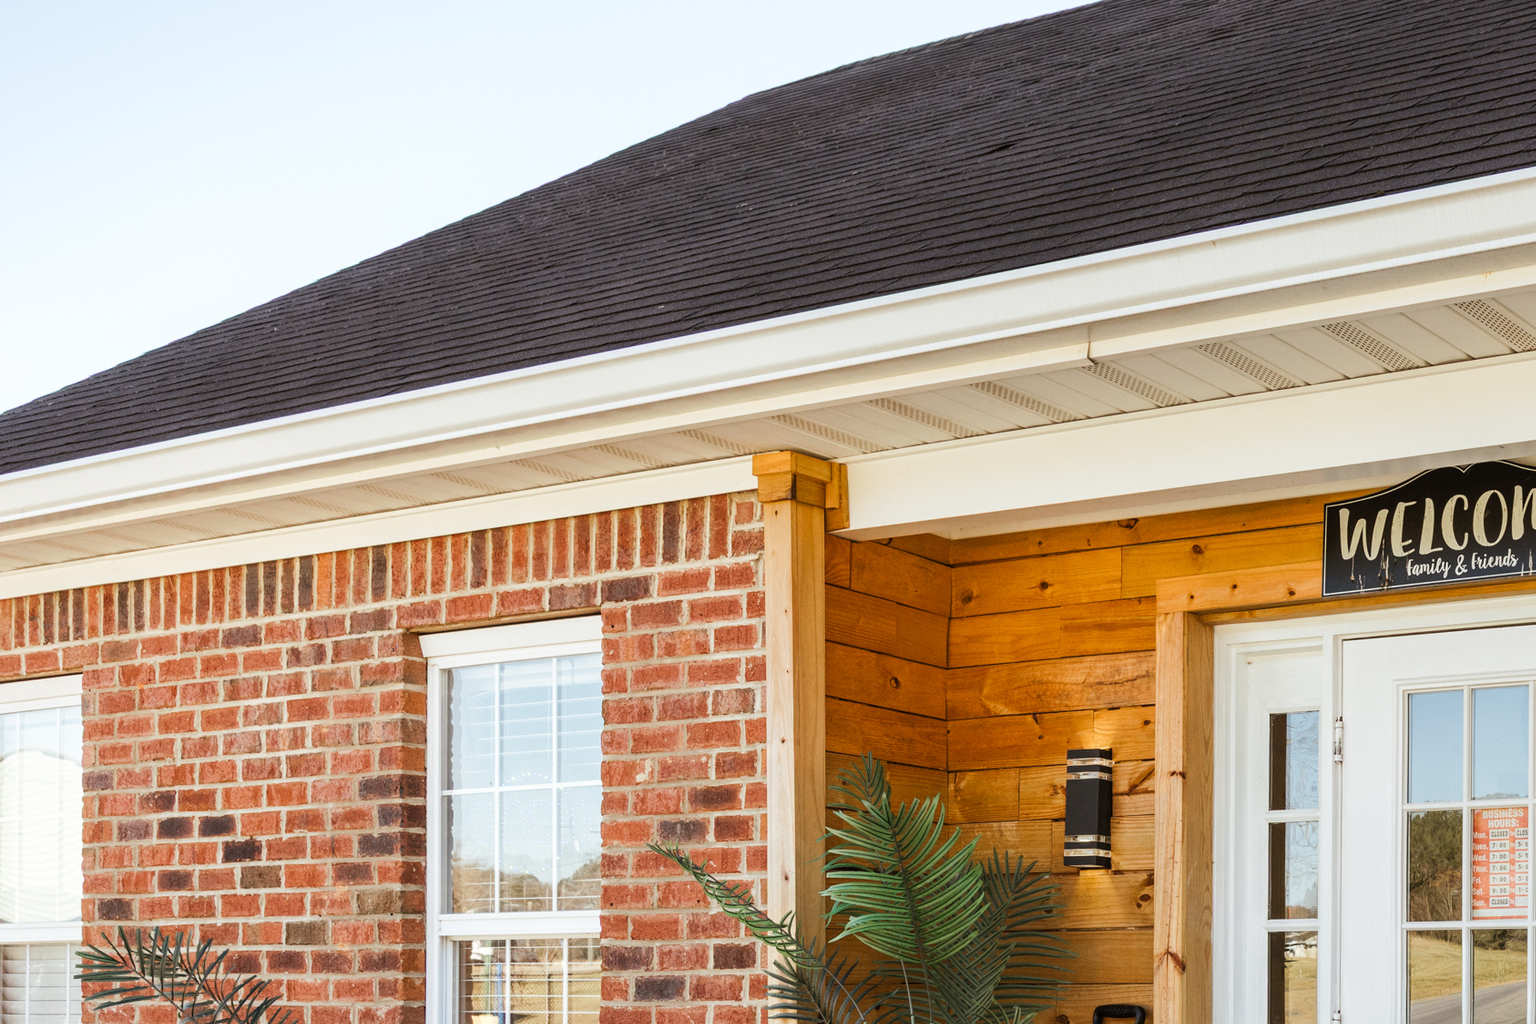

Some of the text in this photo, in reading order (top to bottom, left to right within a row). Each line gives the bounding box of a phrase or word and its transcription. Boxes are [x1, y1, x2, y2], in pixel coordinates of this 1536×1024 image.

[1455, 554, 1468, 575] &
[1471, 548, 1519, 570] Friends
[1482, 808, 1524, 819] BUSINESS
[1488, 818, 1519, 829] HOURS:
[1491, 830, 1508, 838] CLOSED
